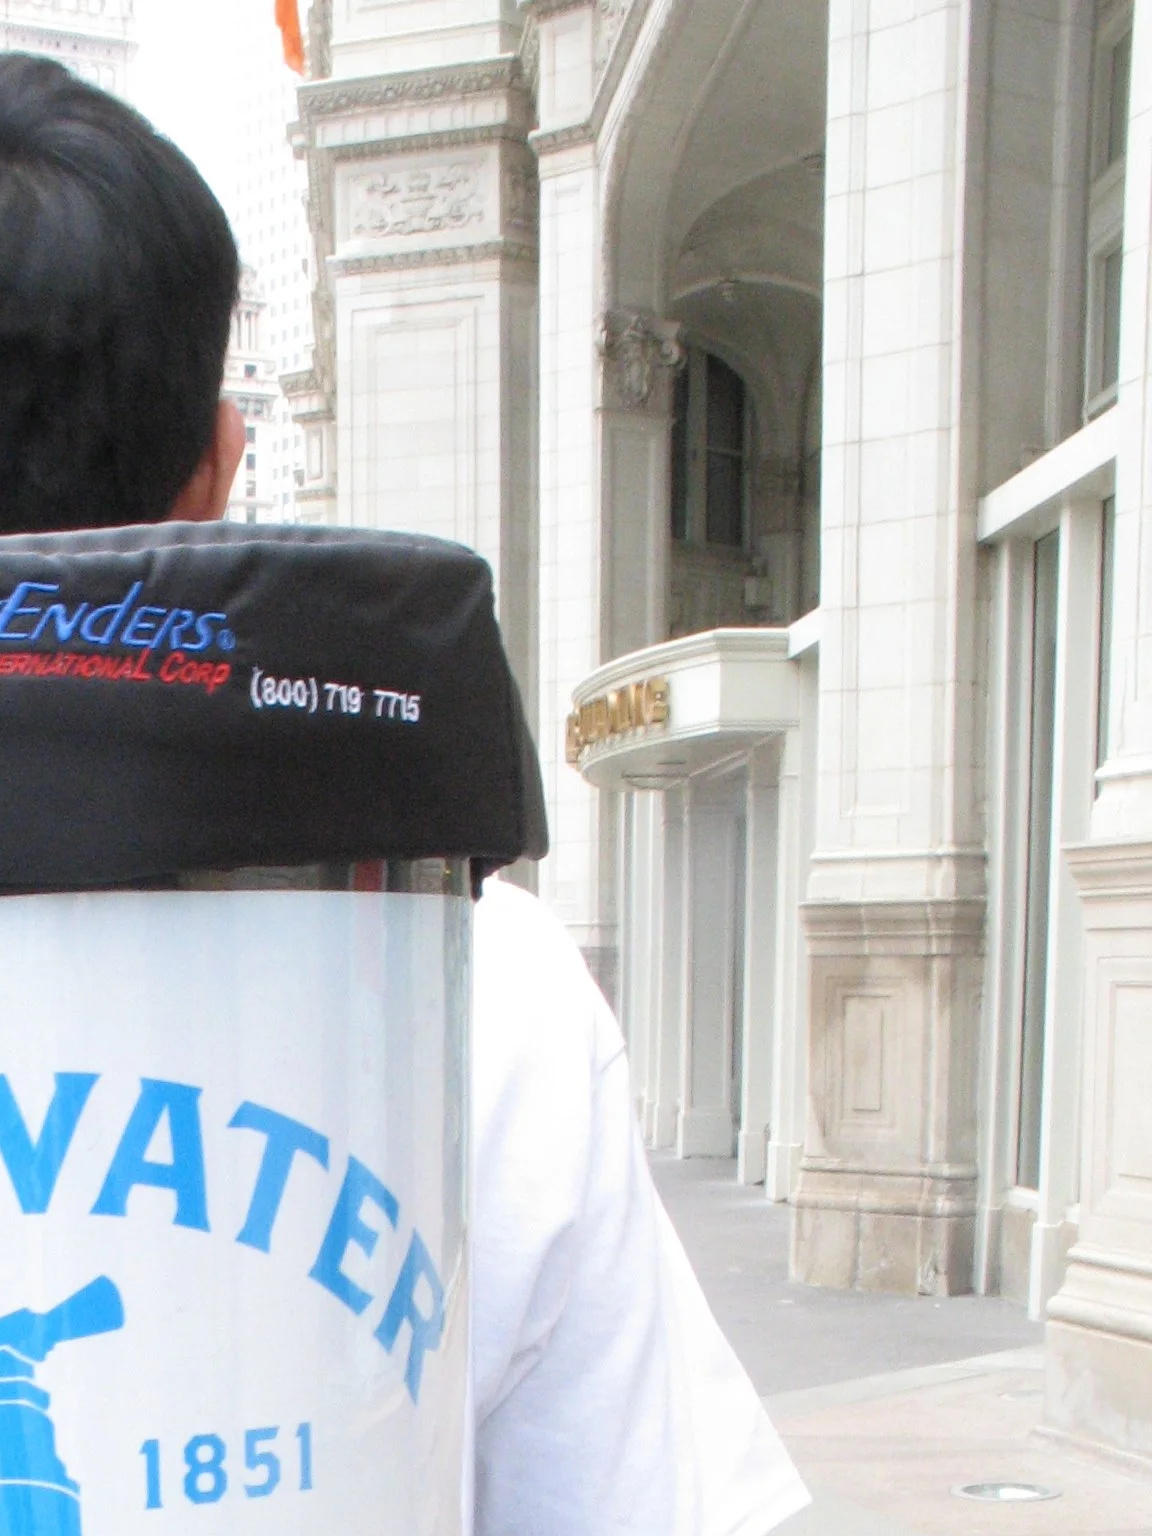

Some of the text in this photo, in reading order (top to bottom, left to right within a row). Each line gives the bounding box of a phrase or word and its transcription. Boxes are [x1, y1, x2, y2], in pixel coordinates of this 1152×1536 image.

[250, 665, 422, 723] (800) 719 7715
[138, 1421, 314, 1511] 1851
